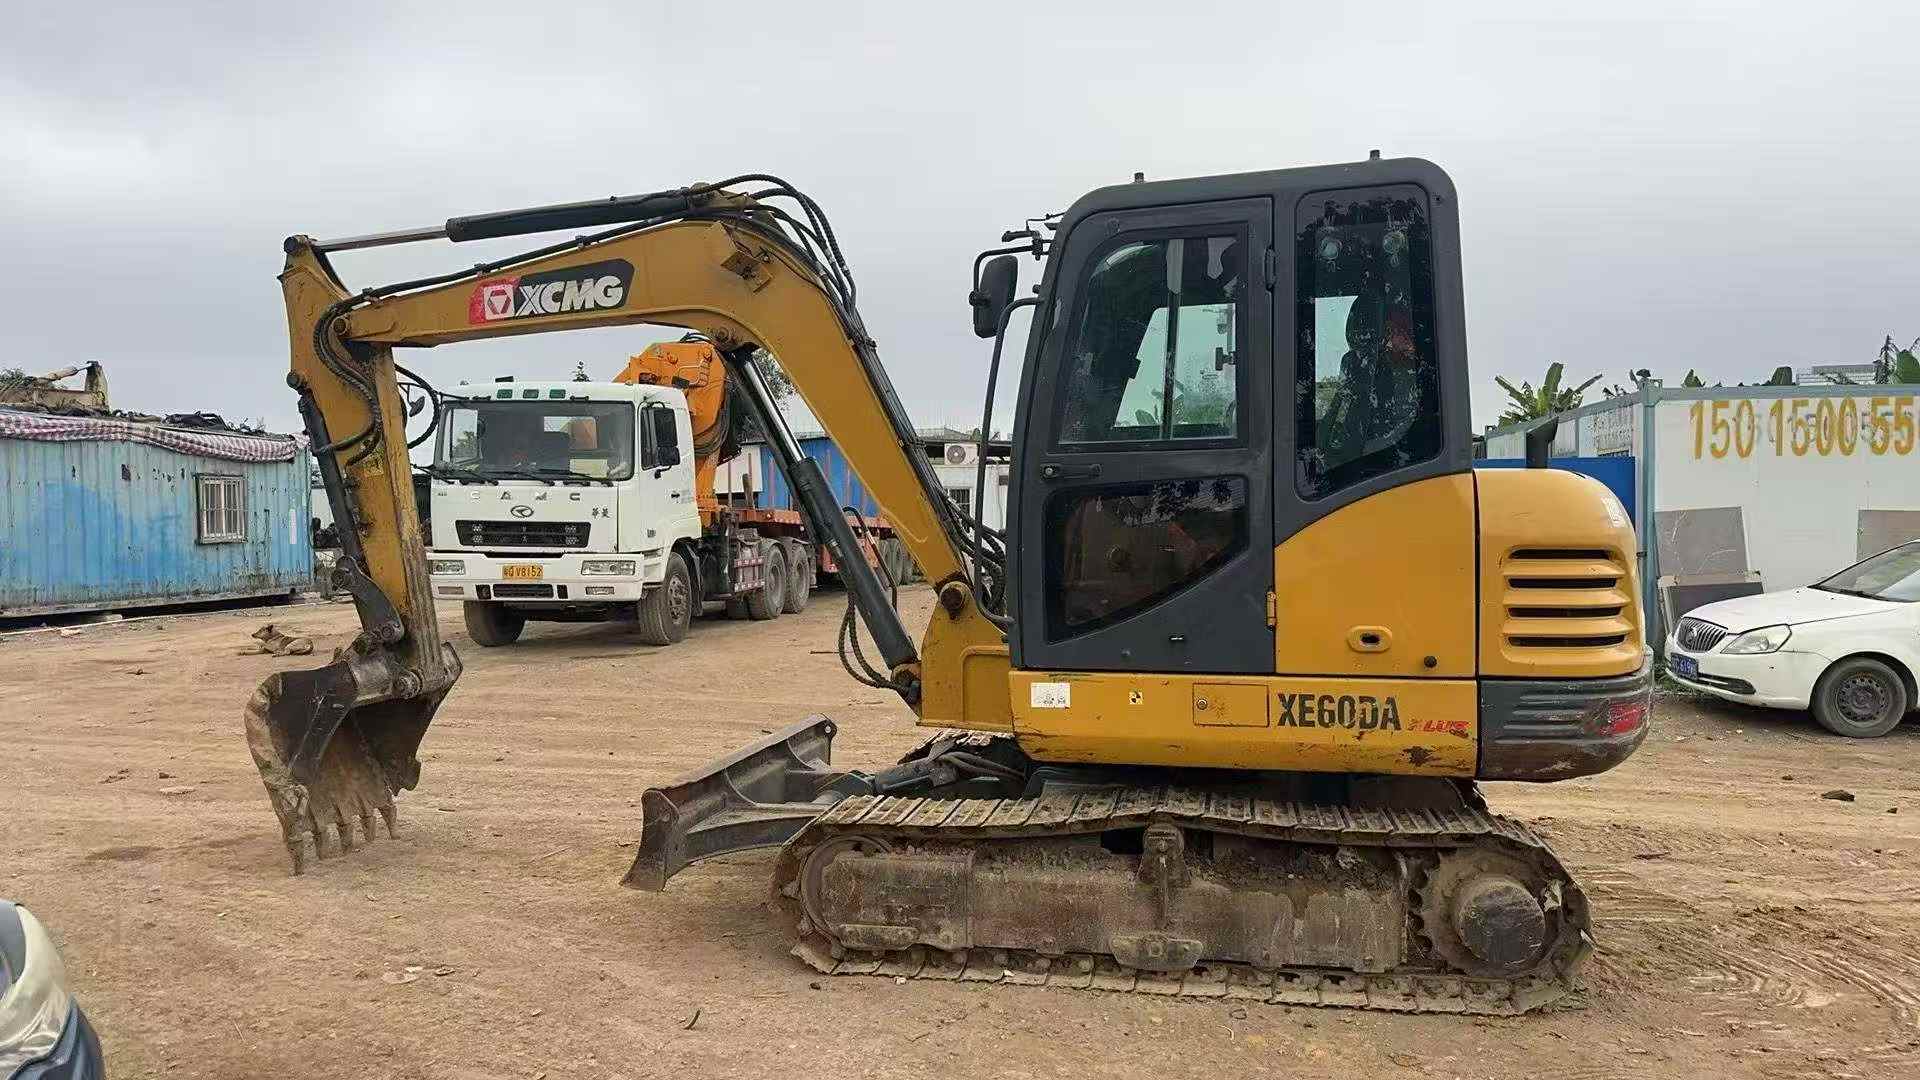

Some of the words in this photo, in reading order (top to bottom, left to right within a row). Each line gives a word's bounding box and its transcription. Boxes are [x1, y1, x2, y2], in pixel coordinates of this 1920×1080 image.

[515, 275, 623, 316] XCMG
[1690, 399, 1755, 459] 150
[1768, 396, 1858, 456] 1500
[1871, 394, 1920, 456] 55
[1277, 693, 1402, 731] XE60DA
